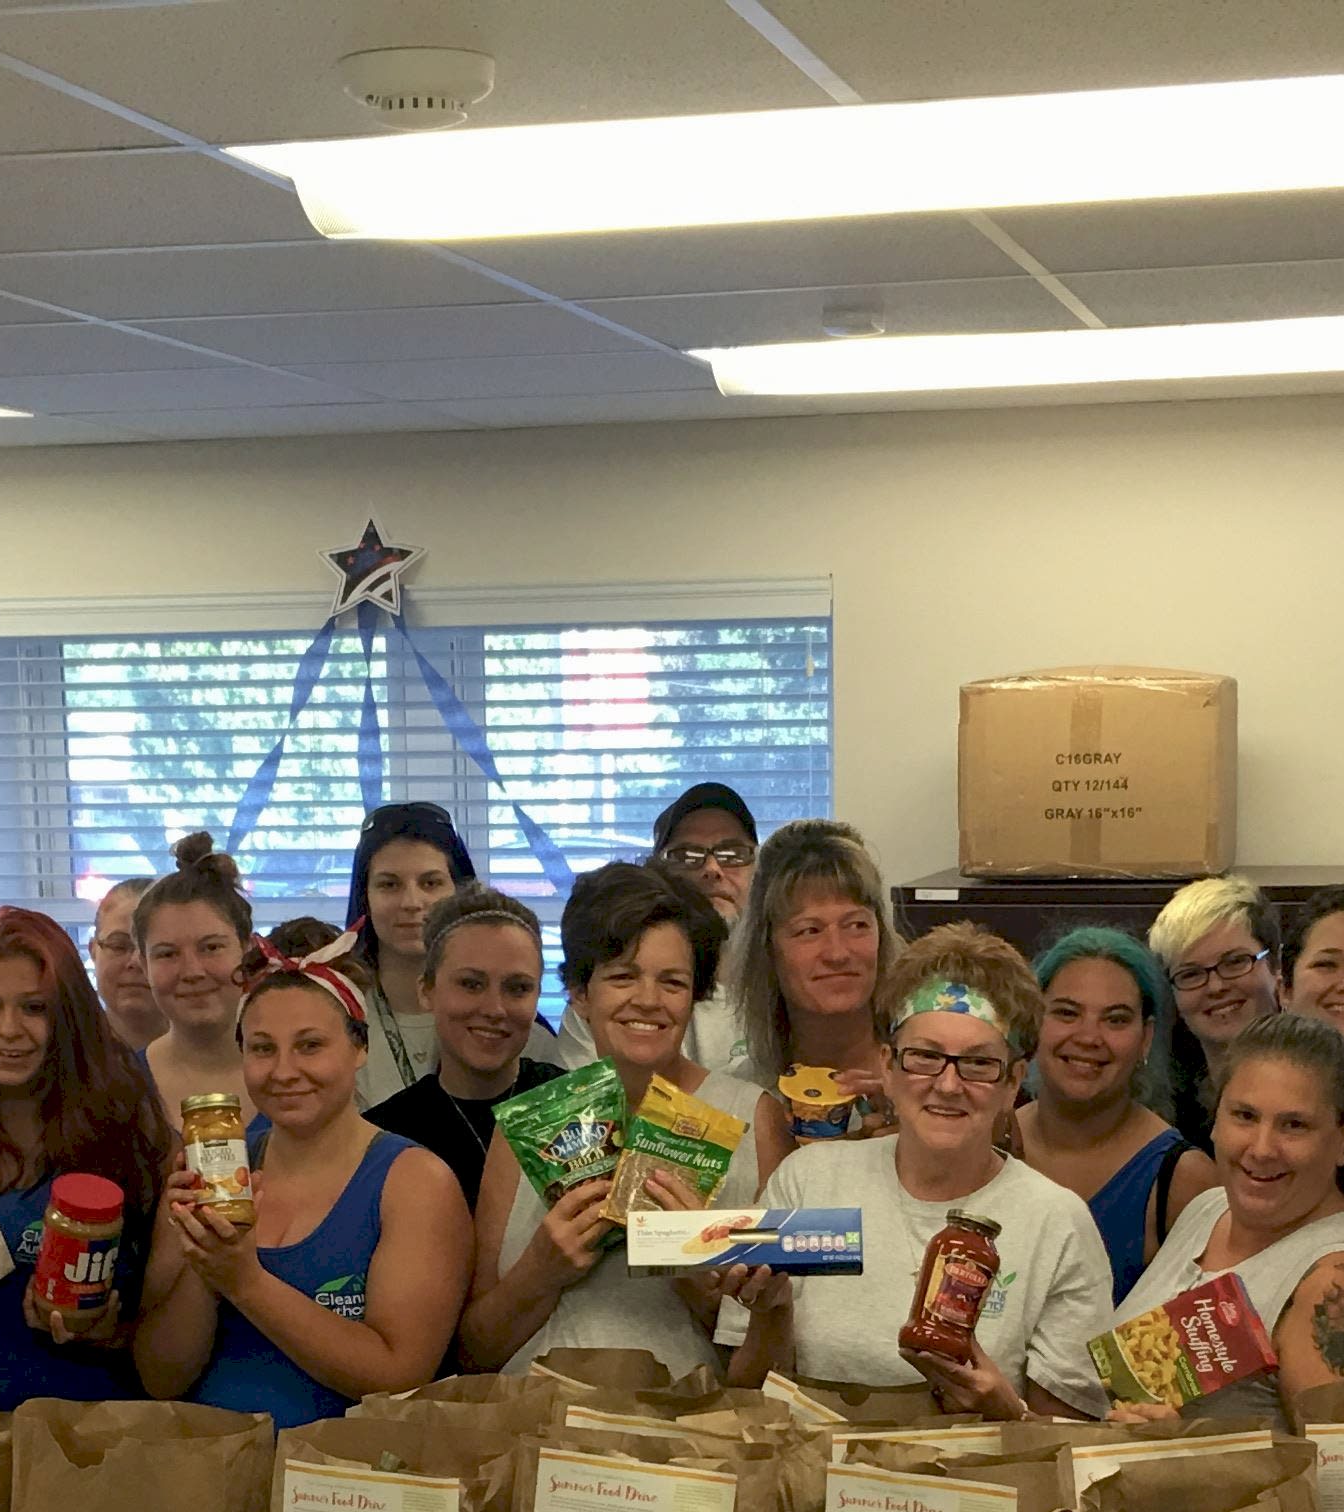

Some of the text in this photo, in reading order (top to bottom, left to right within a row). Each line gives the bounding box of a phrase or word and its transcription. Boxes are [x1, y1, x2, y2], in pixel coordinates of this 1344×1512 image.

[1055, 752, 1122, 766] C16GRAY
[1051, 778, 1129, 793] QTY 12/144
[1044, 807, 1083, 820] GRAY
[633, 1133, 724, 1170] Sunflower Nuts
[64, 1247, 119, 1282] Jif
[1180, 1316, 1215, 1373] Stuffing
[1194, 1298, 1238, 1374] Homestyle
[549, 1474, 658, 1502] Summer Food Drive
[837, 1489, 882, 1509] Summer
[884, 1496, 908, 1512] Food
